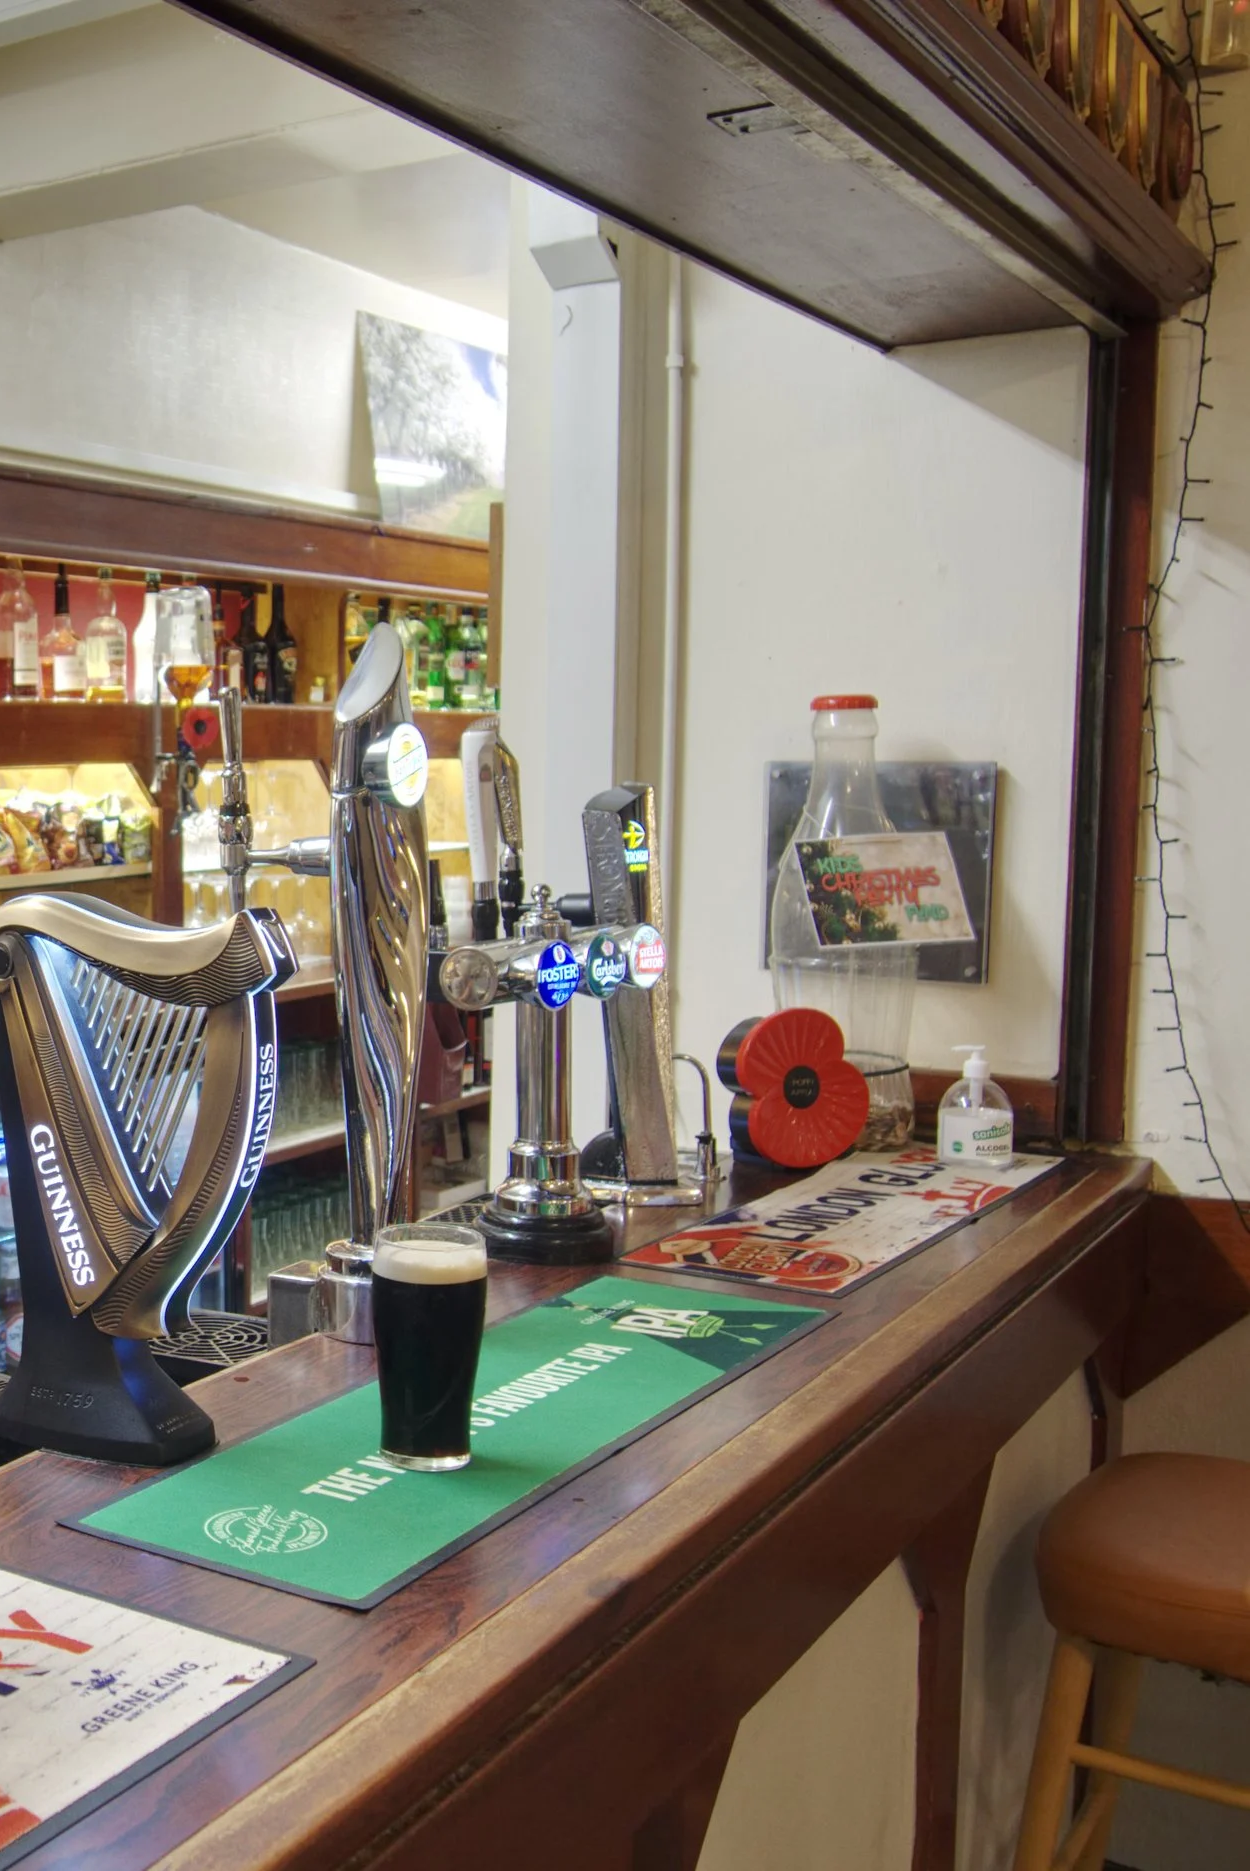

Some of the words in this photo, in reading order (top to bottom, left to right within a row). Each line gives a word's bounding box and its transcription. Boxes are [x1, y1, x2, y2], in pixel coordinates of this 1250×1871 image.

[816, 855, 863, 875] KIDS
[639, 945, 664, 958] STELLA
[240, 1043, 274, 1188] GUINNESS
[30, 1124, 95, 1286] GUINNESS
[742, 1185, 898, 1243] LONDON
[611, 1307, 711, 1339] IPA
[300, 1467, 393, 1501] THE
[480, 1357, 601, 1418] FAVOURITE
[566, 1341, 633, 1363] IPA
[80, 1687, 156, 1734] GREENE
[150, 1660, 199, 1690] KING
